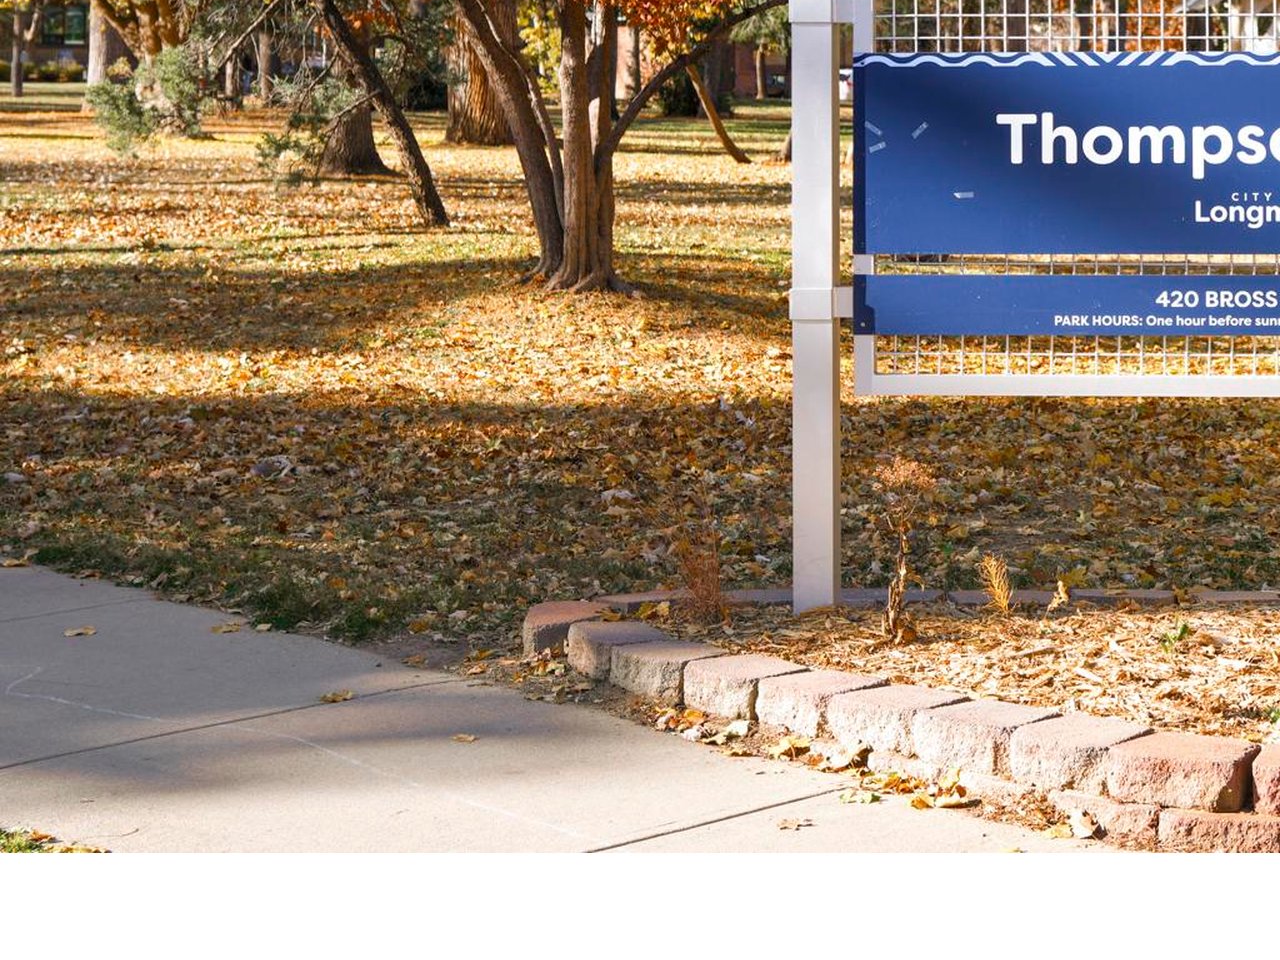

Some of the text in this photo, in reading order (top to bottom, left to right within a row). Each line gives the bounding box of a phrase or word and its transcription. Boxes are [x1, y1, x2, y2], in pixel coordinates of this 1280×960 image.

[1231, 192, 1273, 202] CITY
[1155, 290, 1200, 308] 420
[1205, 290, 1279, 308] BROSS
[1054, 314, 1090, 327] PARK
[1092, 314, 1143, 327] HOURS:
[1145, 314, 1174, 327] One
[1175, 314, 1207, 327] hour
[1208, 314, 1253, 327] before
